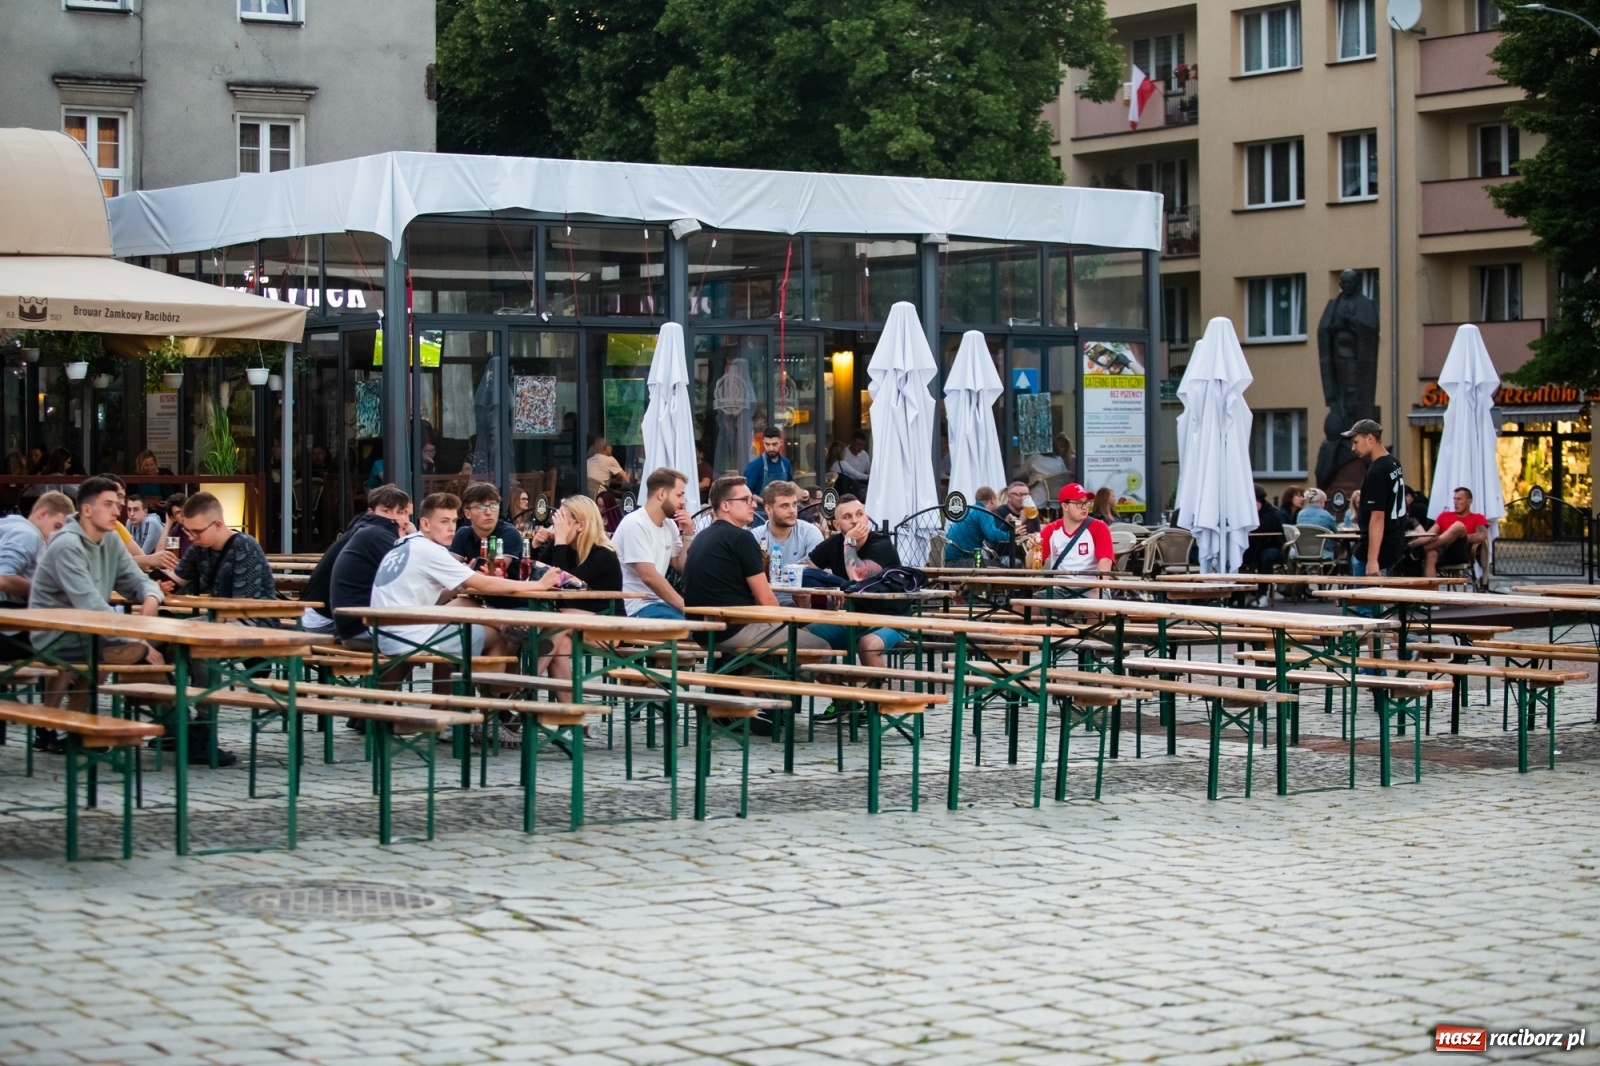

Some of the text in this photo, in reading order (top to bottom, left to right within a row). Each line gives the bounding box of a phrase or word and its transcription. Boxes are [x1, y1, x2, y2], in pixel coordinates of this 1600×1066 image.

[73, 305, 180, 323] Browar Zamkowy Racibórz
